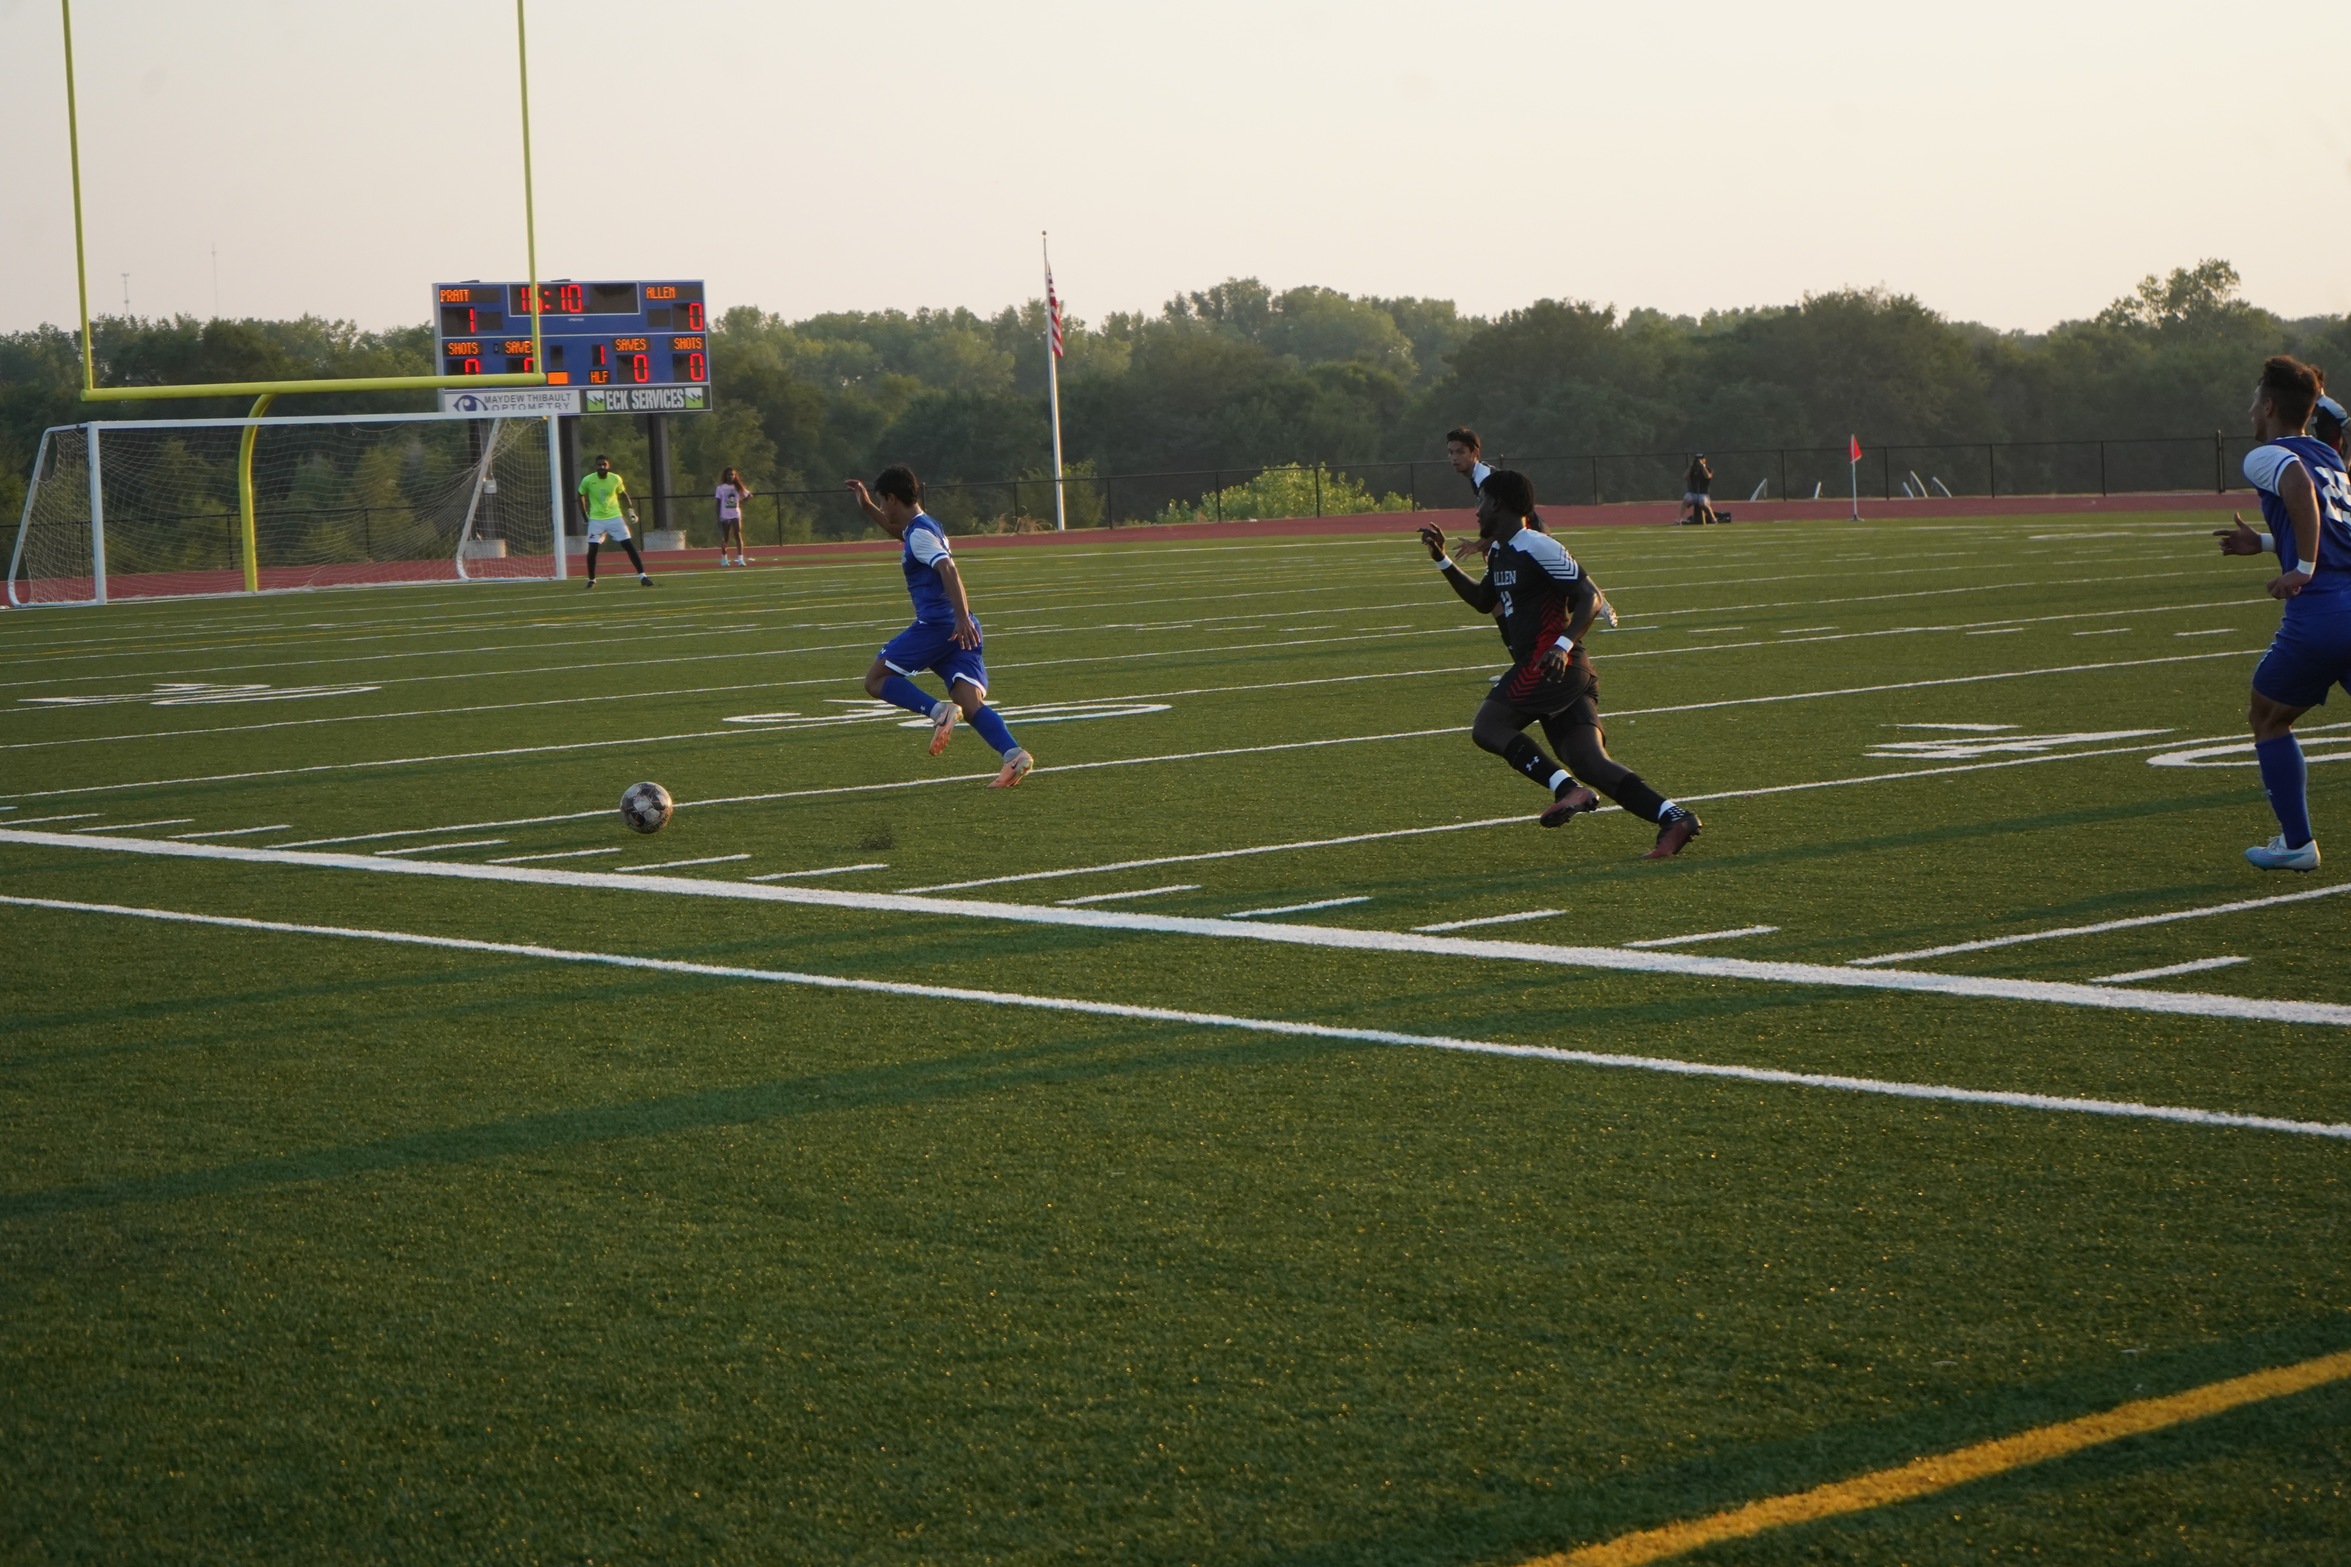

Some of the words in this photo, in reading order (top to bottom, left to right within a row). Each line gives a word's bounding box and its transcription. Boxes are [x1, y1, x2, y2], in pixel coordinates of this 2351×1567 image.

[440, 289, 470, 303] PRATT
[646, 286, 676, 299] ALLEN
[469, 308, 475, 333] 1
[689, 302, 704, 331] 0
[447, 342, 479, 355] SHOTS
[615, 338, 647, 351] SAVES
[674, 337, 703, 350] SHOTS
[600, 345, 606, 365] 1
[633, 354, 649, 383] 0
[689, 353, 705, 381] 0
[590, 371, 609, 384] HLF
[484, 394, 525, 404] MAYDEW
[527, 393, 571, 402] THIBAULT
[605, 390, 629, 411] ECK
[631, 388, 685, 410] SERVICES
[491, 402, 570, 411] OPTOMETRY
